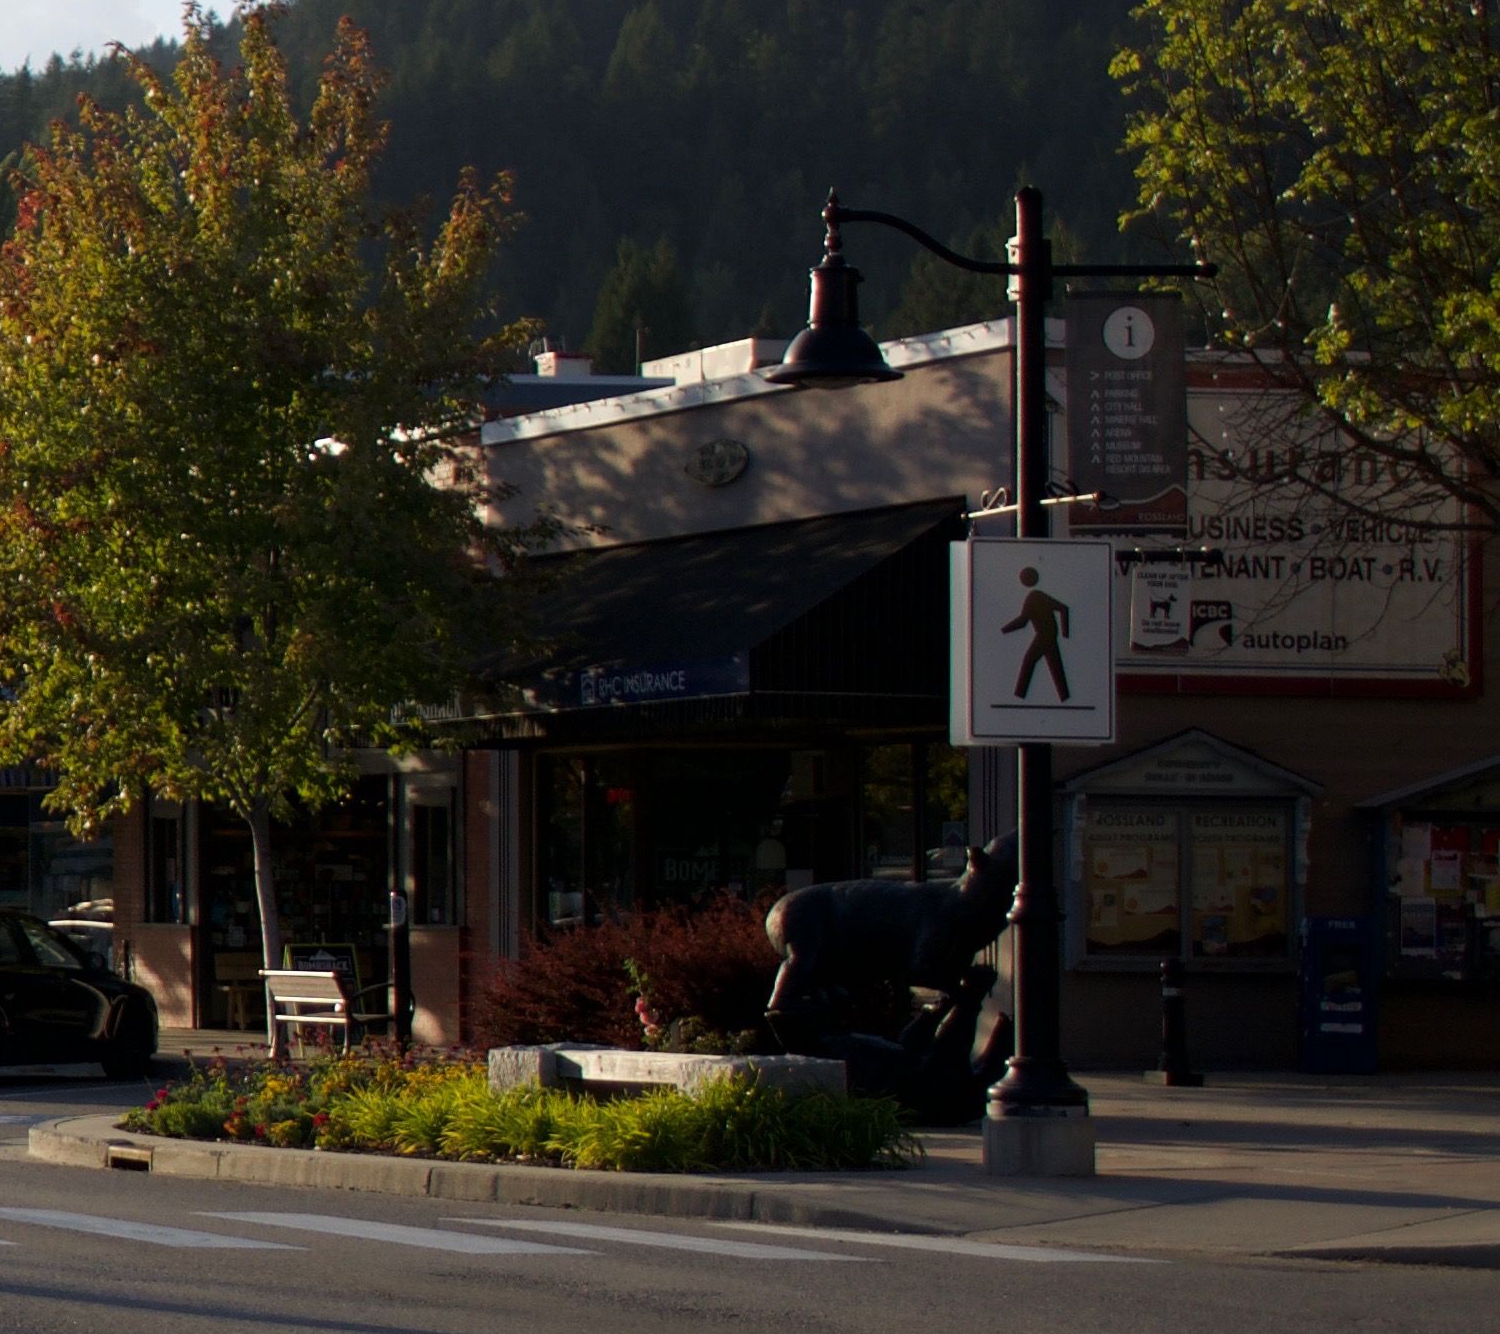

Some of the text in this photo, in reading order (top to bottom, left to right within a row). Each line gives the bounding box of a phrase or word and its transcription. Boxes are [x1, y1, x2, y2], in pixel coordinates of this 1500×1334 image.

[1188, 516, 1434, 546] USINESS VEHICLE
[1309, 556, 1377, 582] BOAT
[1400, 557, 1443, 584] R.V.
[1193, 603, 1231, 618] ICBC
[1242, 630, 1348, 654] autoplan
[623, 670, 687, 695] INSURANCE
[1096, 814, 1278, 828] ROSSLAND RECREATION
